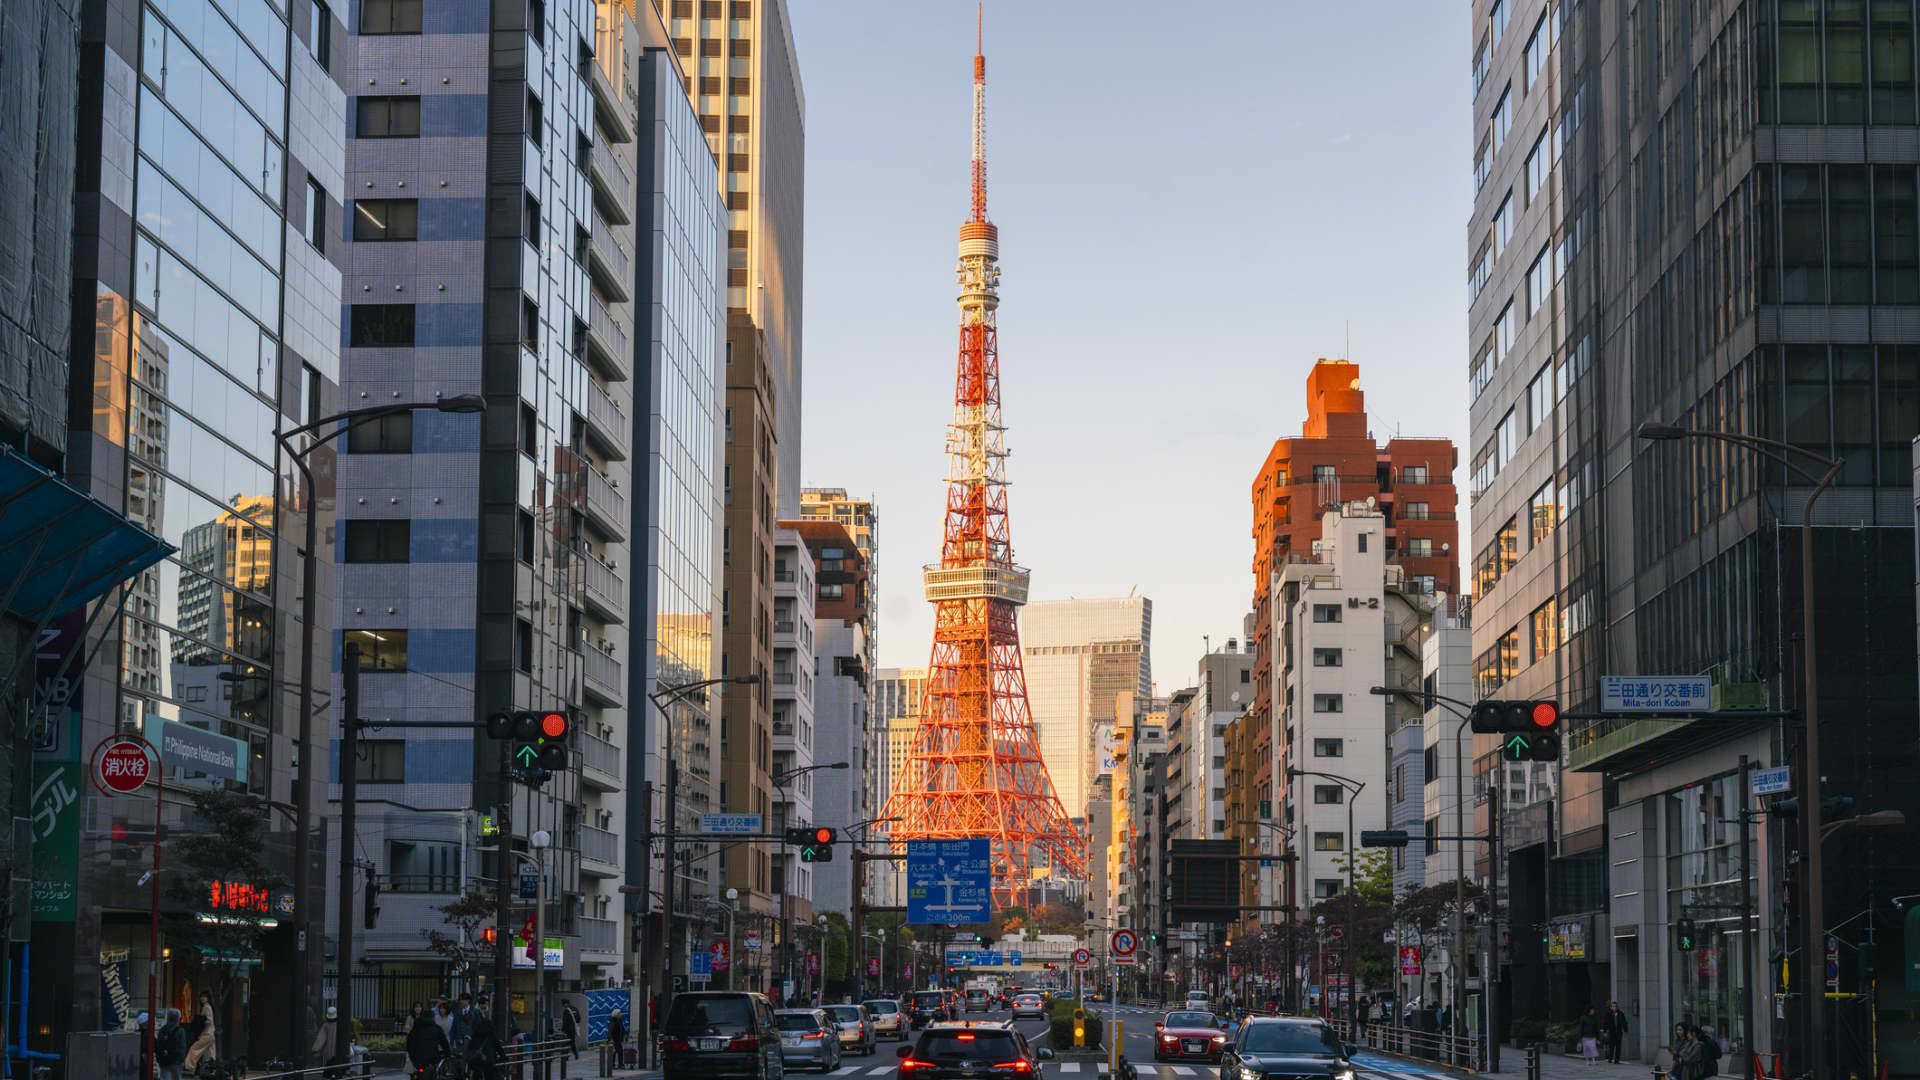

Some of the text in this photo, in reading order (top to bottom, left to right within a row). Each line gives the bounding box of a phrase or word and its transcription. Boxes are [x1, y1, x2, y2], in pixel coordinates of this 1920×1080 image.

[1348, 597, 1378, 609] M-2
[1608, 683, 1706, 698] 三田通り交番前
[1624, 698, 1691, 707] Mita-dori Koban
[171, 737, 235, 769] Philippine National Bank
[105, 757, 146, 777] 消火栓
